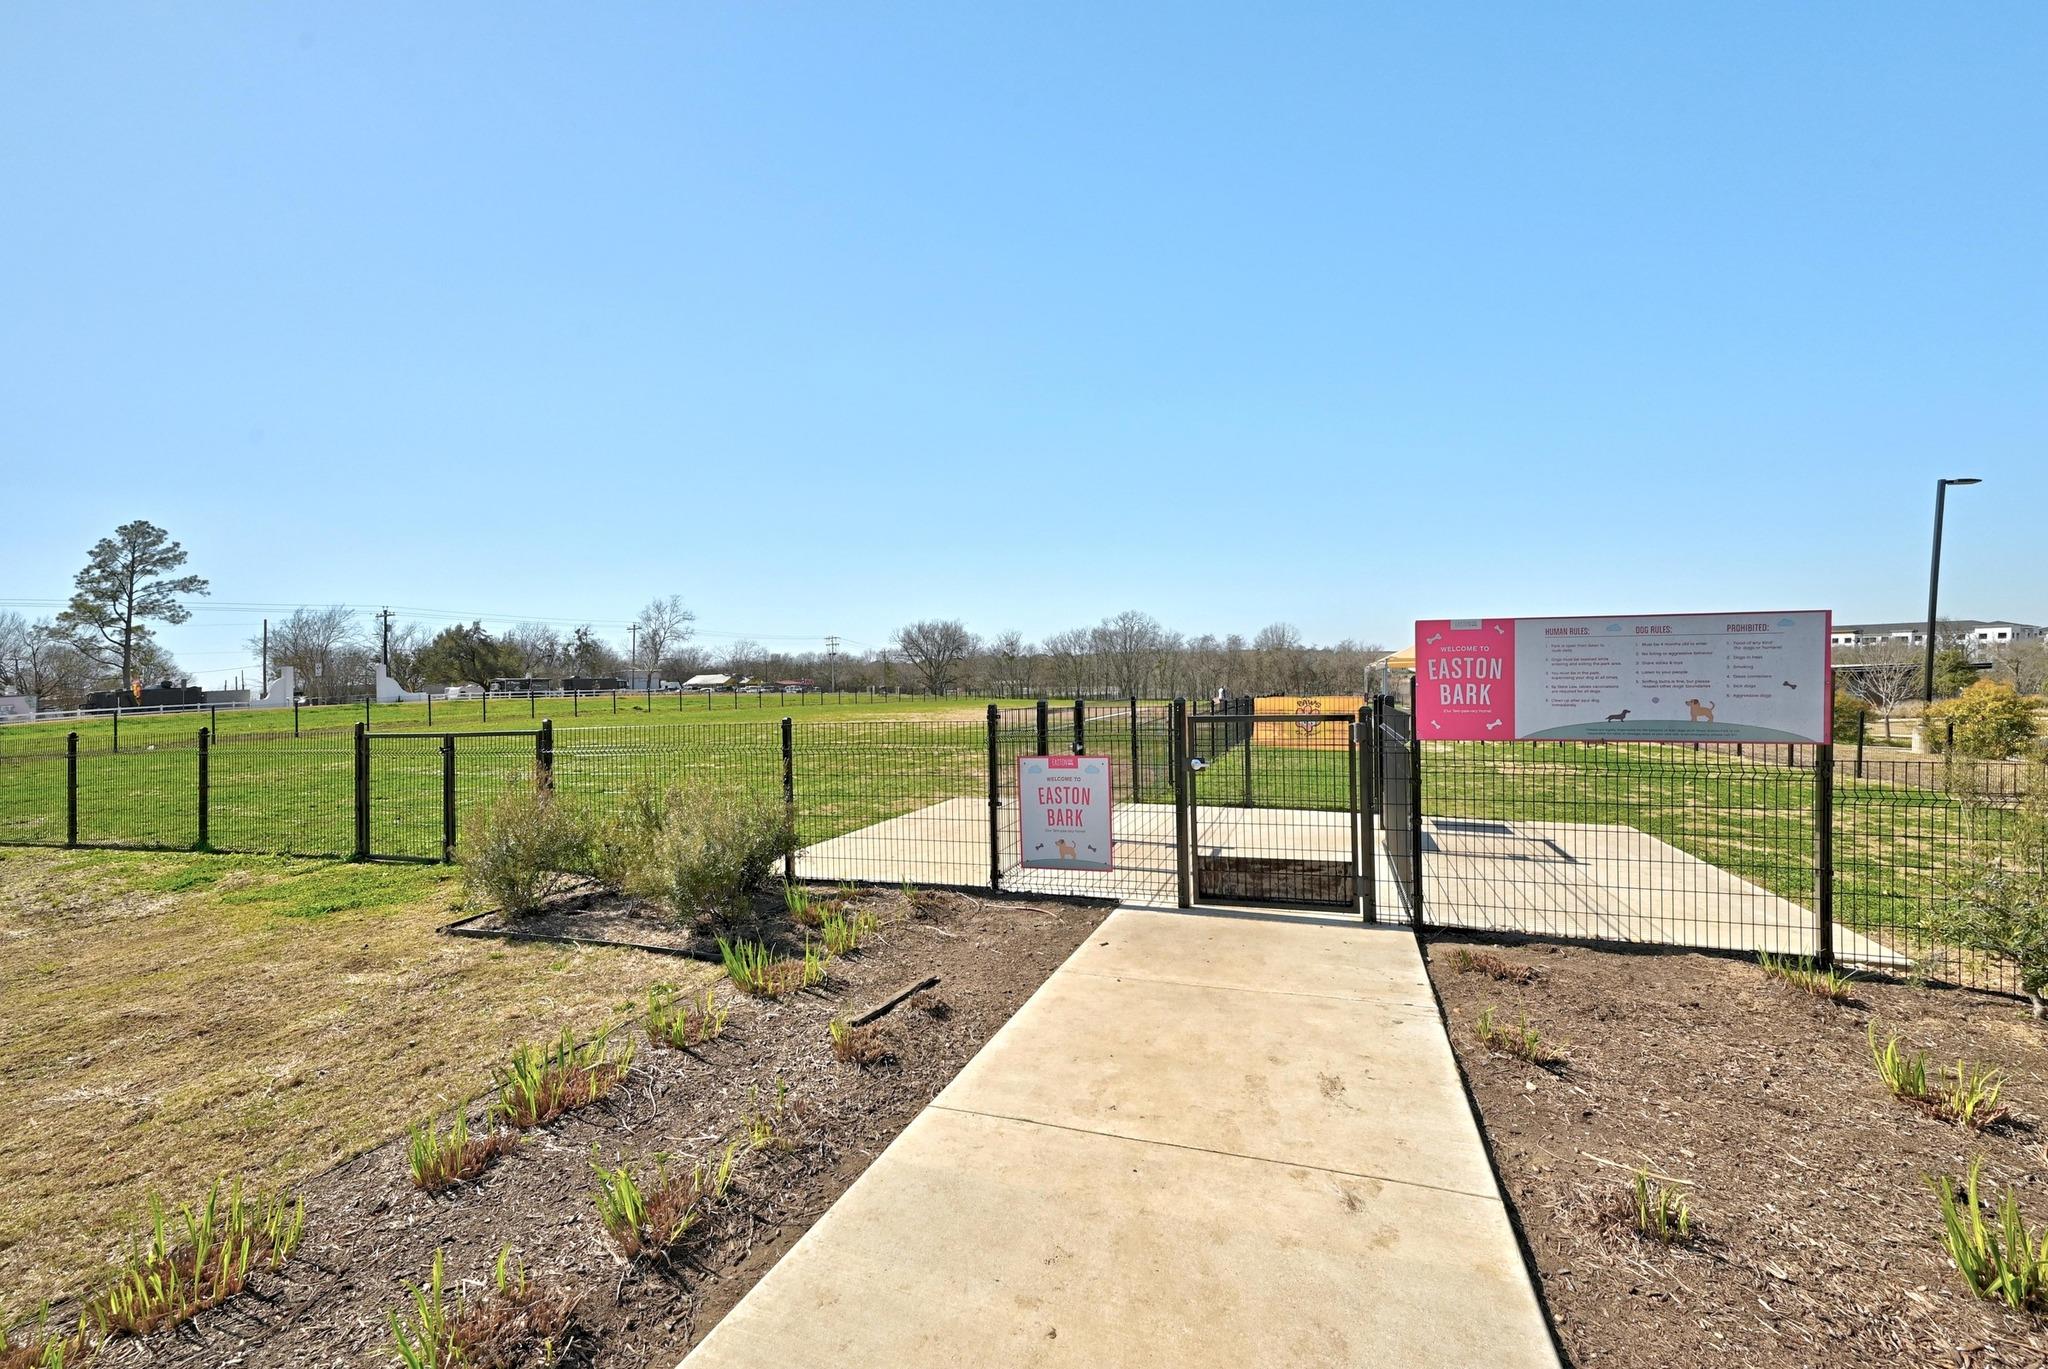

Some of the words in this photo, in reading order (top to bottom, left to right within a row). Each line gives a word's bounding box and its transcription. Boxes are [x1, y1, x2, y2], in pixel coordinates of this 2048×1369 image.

[1545, 628, 1568, 636] HUMAN
[1569, 627, 1590, 635] RULES:
[1635, 626, 1649, 634] DOG
[1650, 625, 1673, 634] RULES:
[1726, 624, 1770, 632] PROHIBITED:
[1441, 645, 1478, 653] WELCOME
[1480, 645, 1490, 653] TO
[1428, 657, 1502, 680] EASTON
[1440, 683, 1492, 706] BARK
[1038, 787, 1091, 806] EASTON
[1047, 809, 1083, 828] BARK
